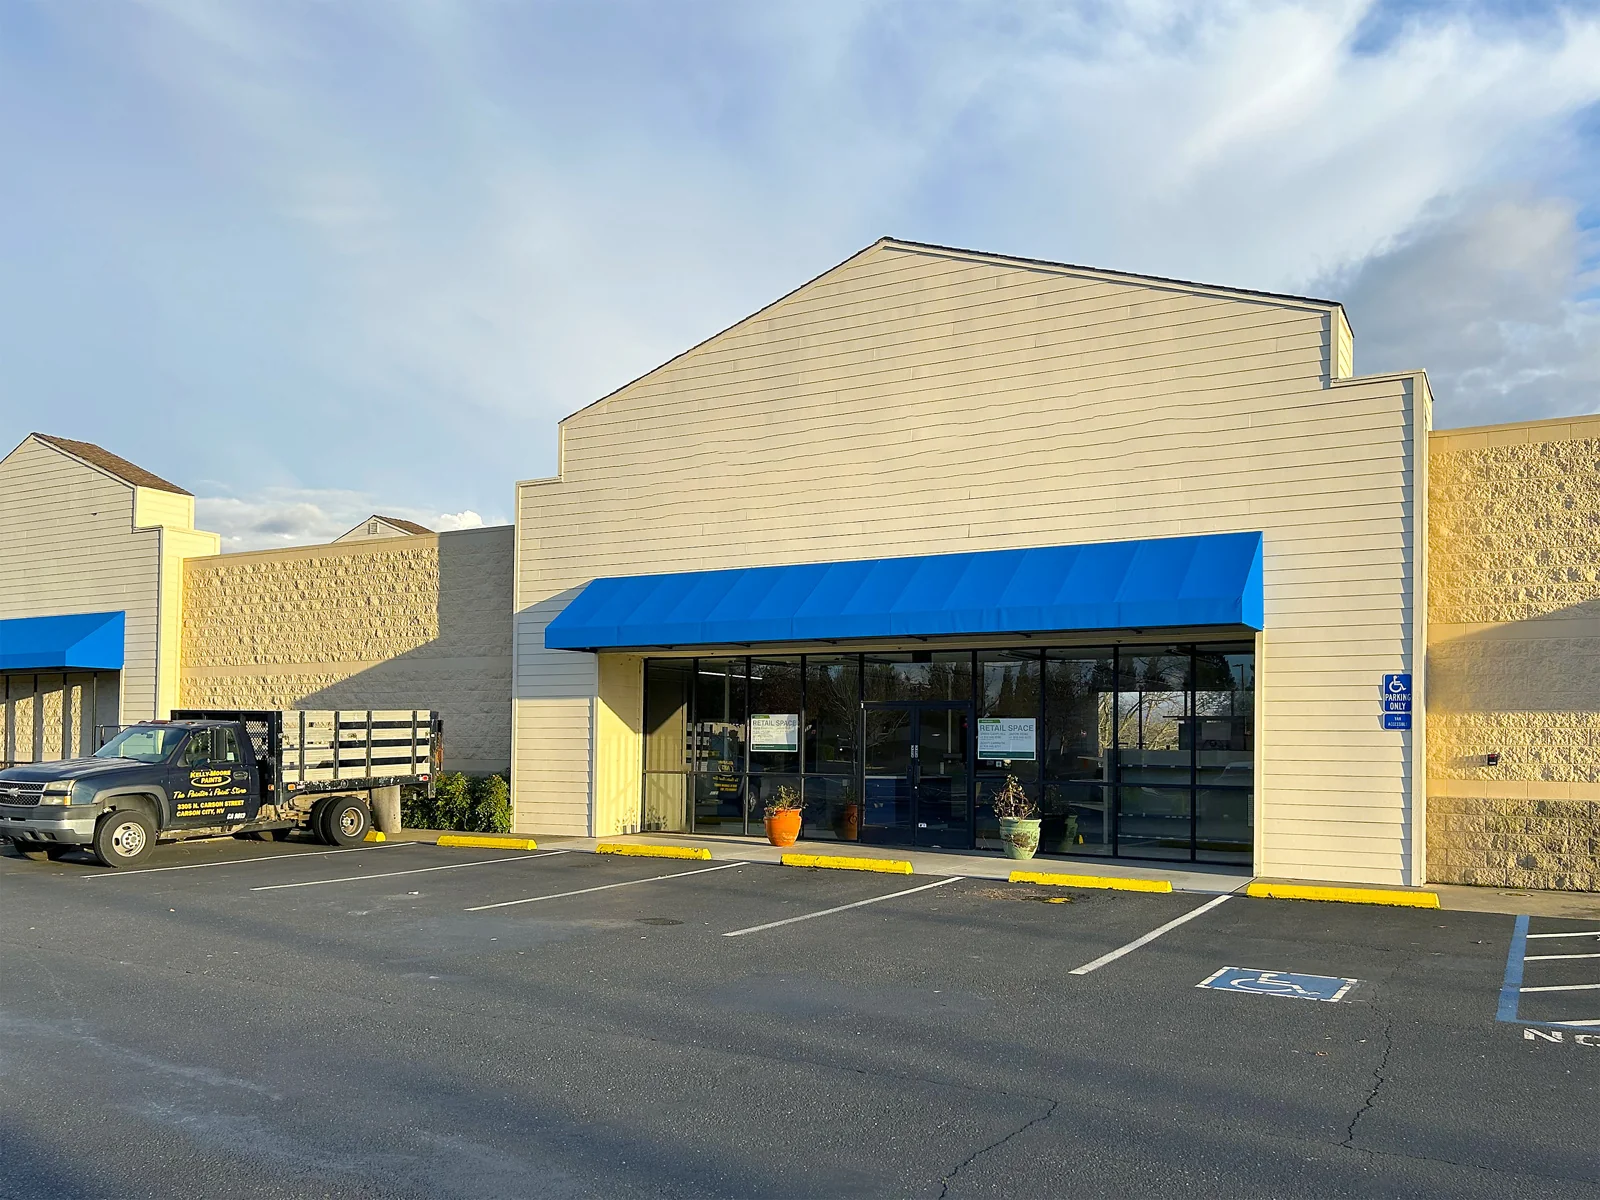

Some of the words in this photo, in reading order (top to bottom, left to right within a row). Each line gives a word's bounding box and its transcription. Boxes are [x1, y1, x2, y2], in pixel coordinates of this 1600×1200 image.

[1385, 693, 1411, 701] PARKING
[1389, 702, 1406, 710] ONLY
[752, 719, 775, 727] RETAIL
[775, 719, 797, 727] SPACE
[979, 724, 1007, 732] RETAIL
[1007, 724, 1034, 732] SPACE
[190, 769, 231, 779] KELLY-MOORE
[200, 776, 223, 784] PAINTS
[176, 809, 201, 817] CARSON
